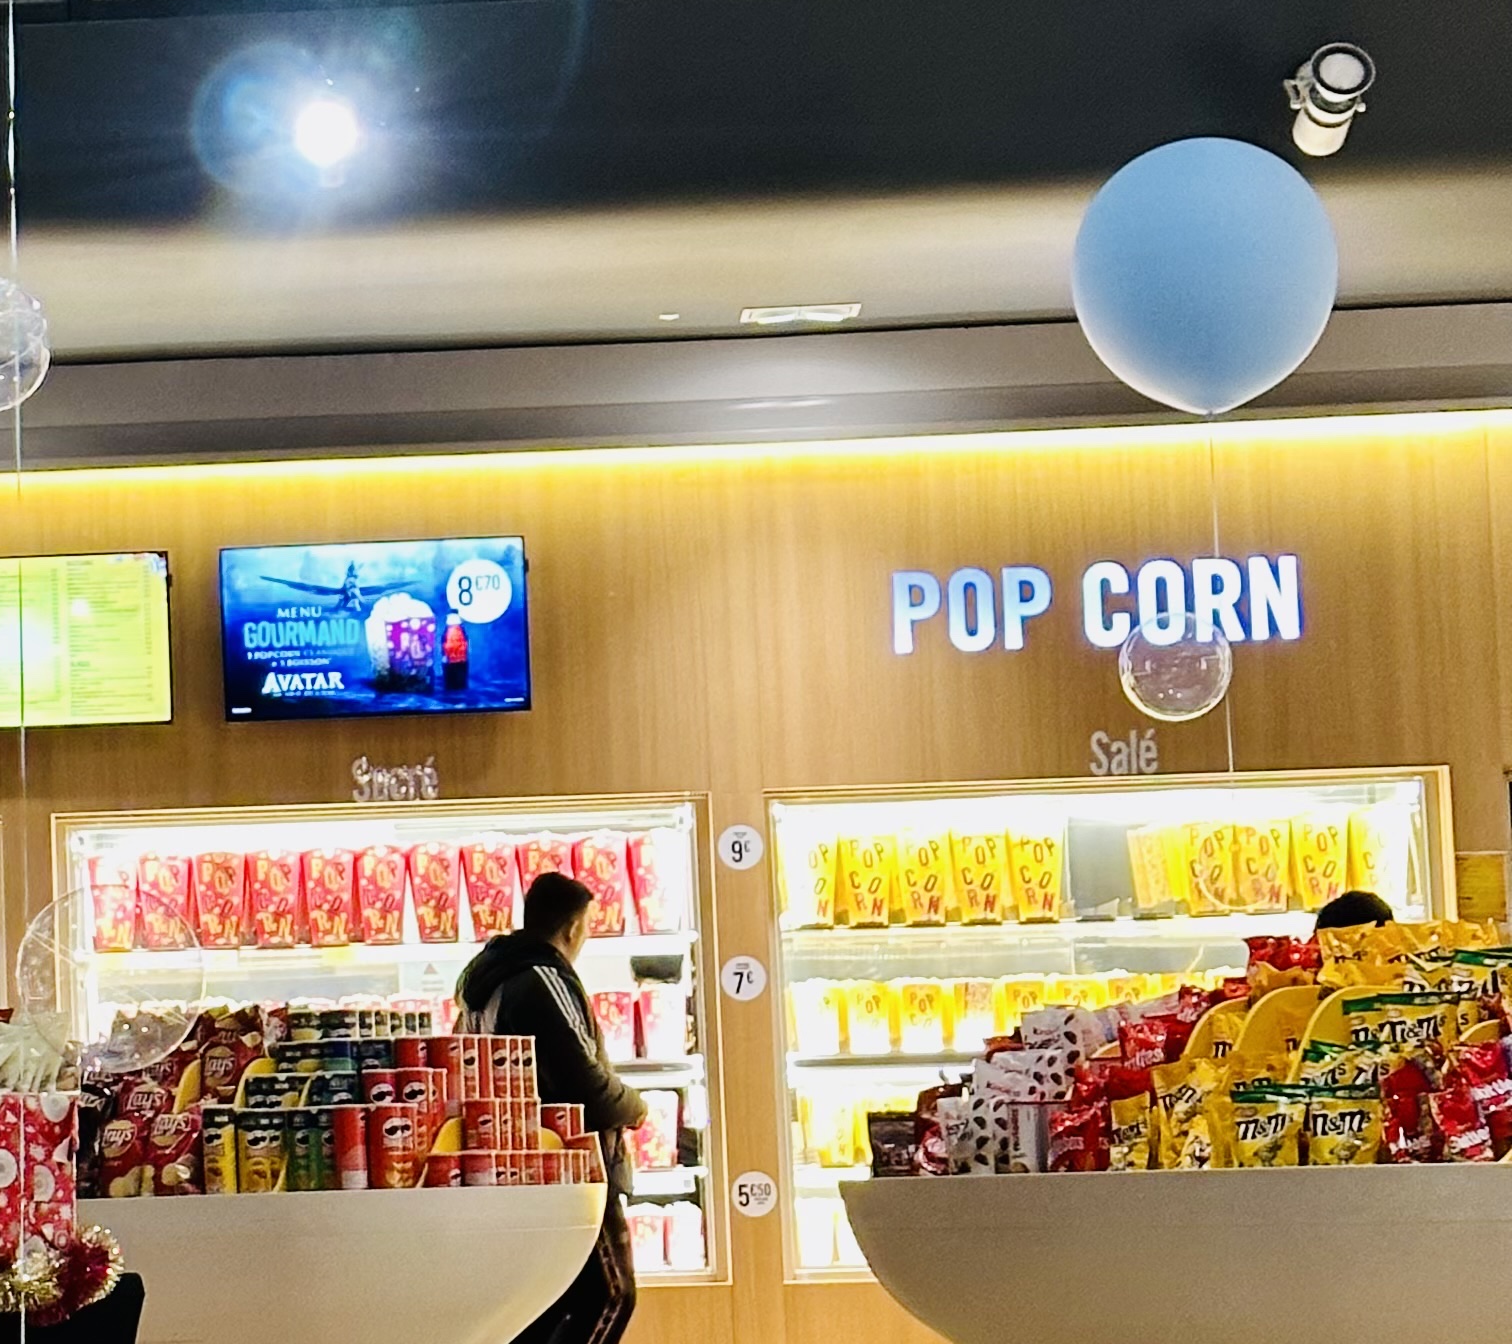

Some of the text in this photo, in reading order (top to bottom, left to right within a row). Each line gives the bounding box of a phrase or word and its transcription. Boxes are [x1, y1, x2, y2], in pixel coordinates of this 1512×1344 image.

[276, 605, 323, 619] MENU
[891, 553, 1302, 655] POP CORN
[243, 617, 361, 649] GOURMAND
[261, 671, 345, 694] AVATAR
[1089, 727, 1160, 776] Salé
[351, 755, 440, 803] Sucré
